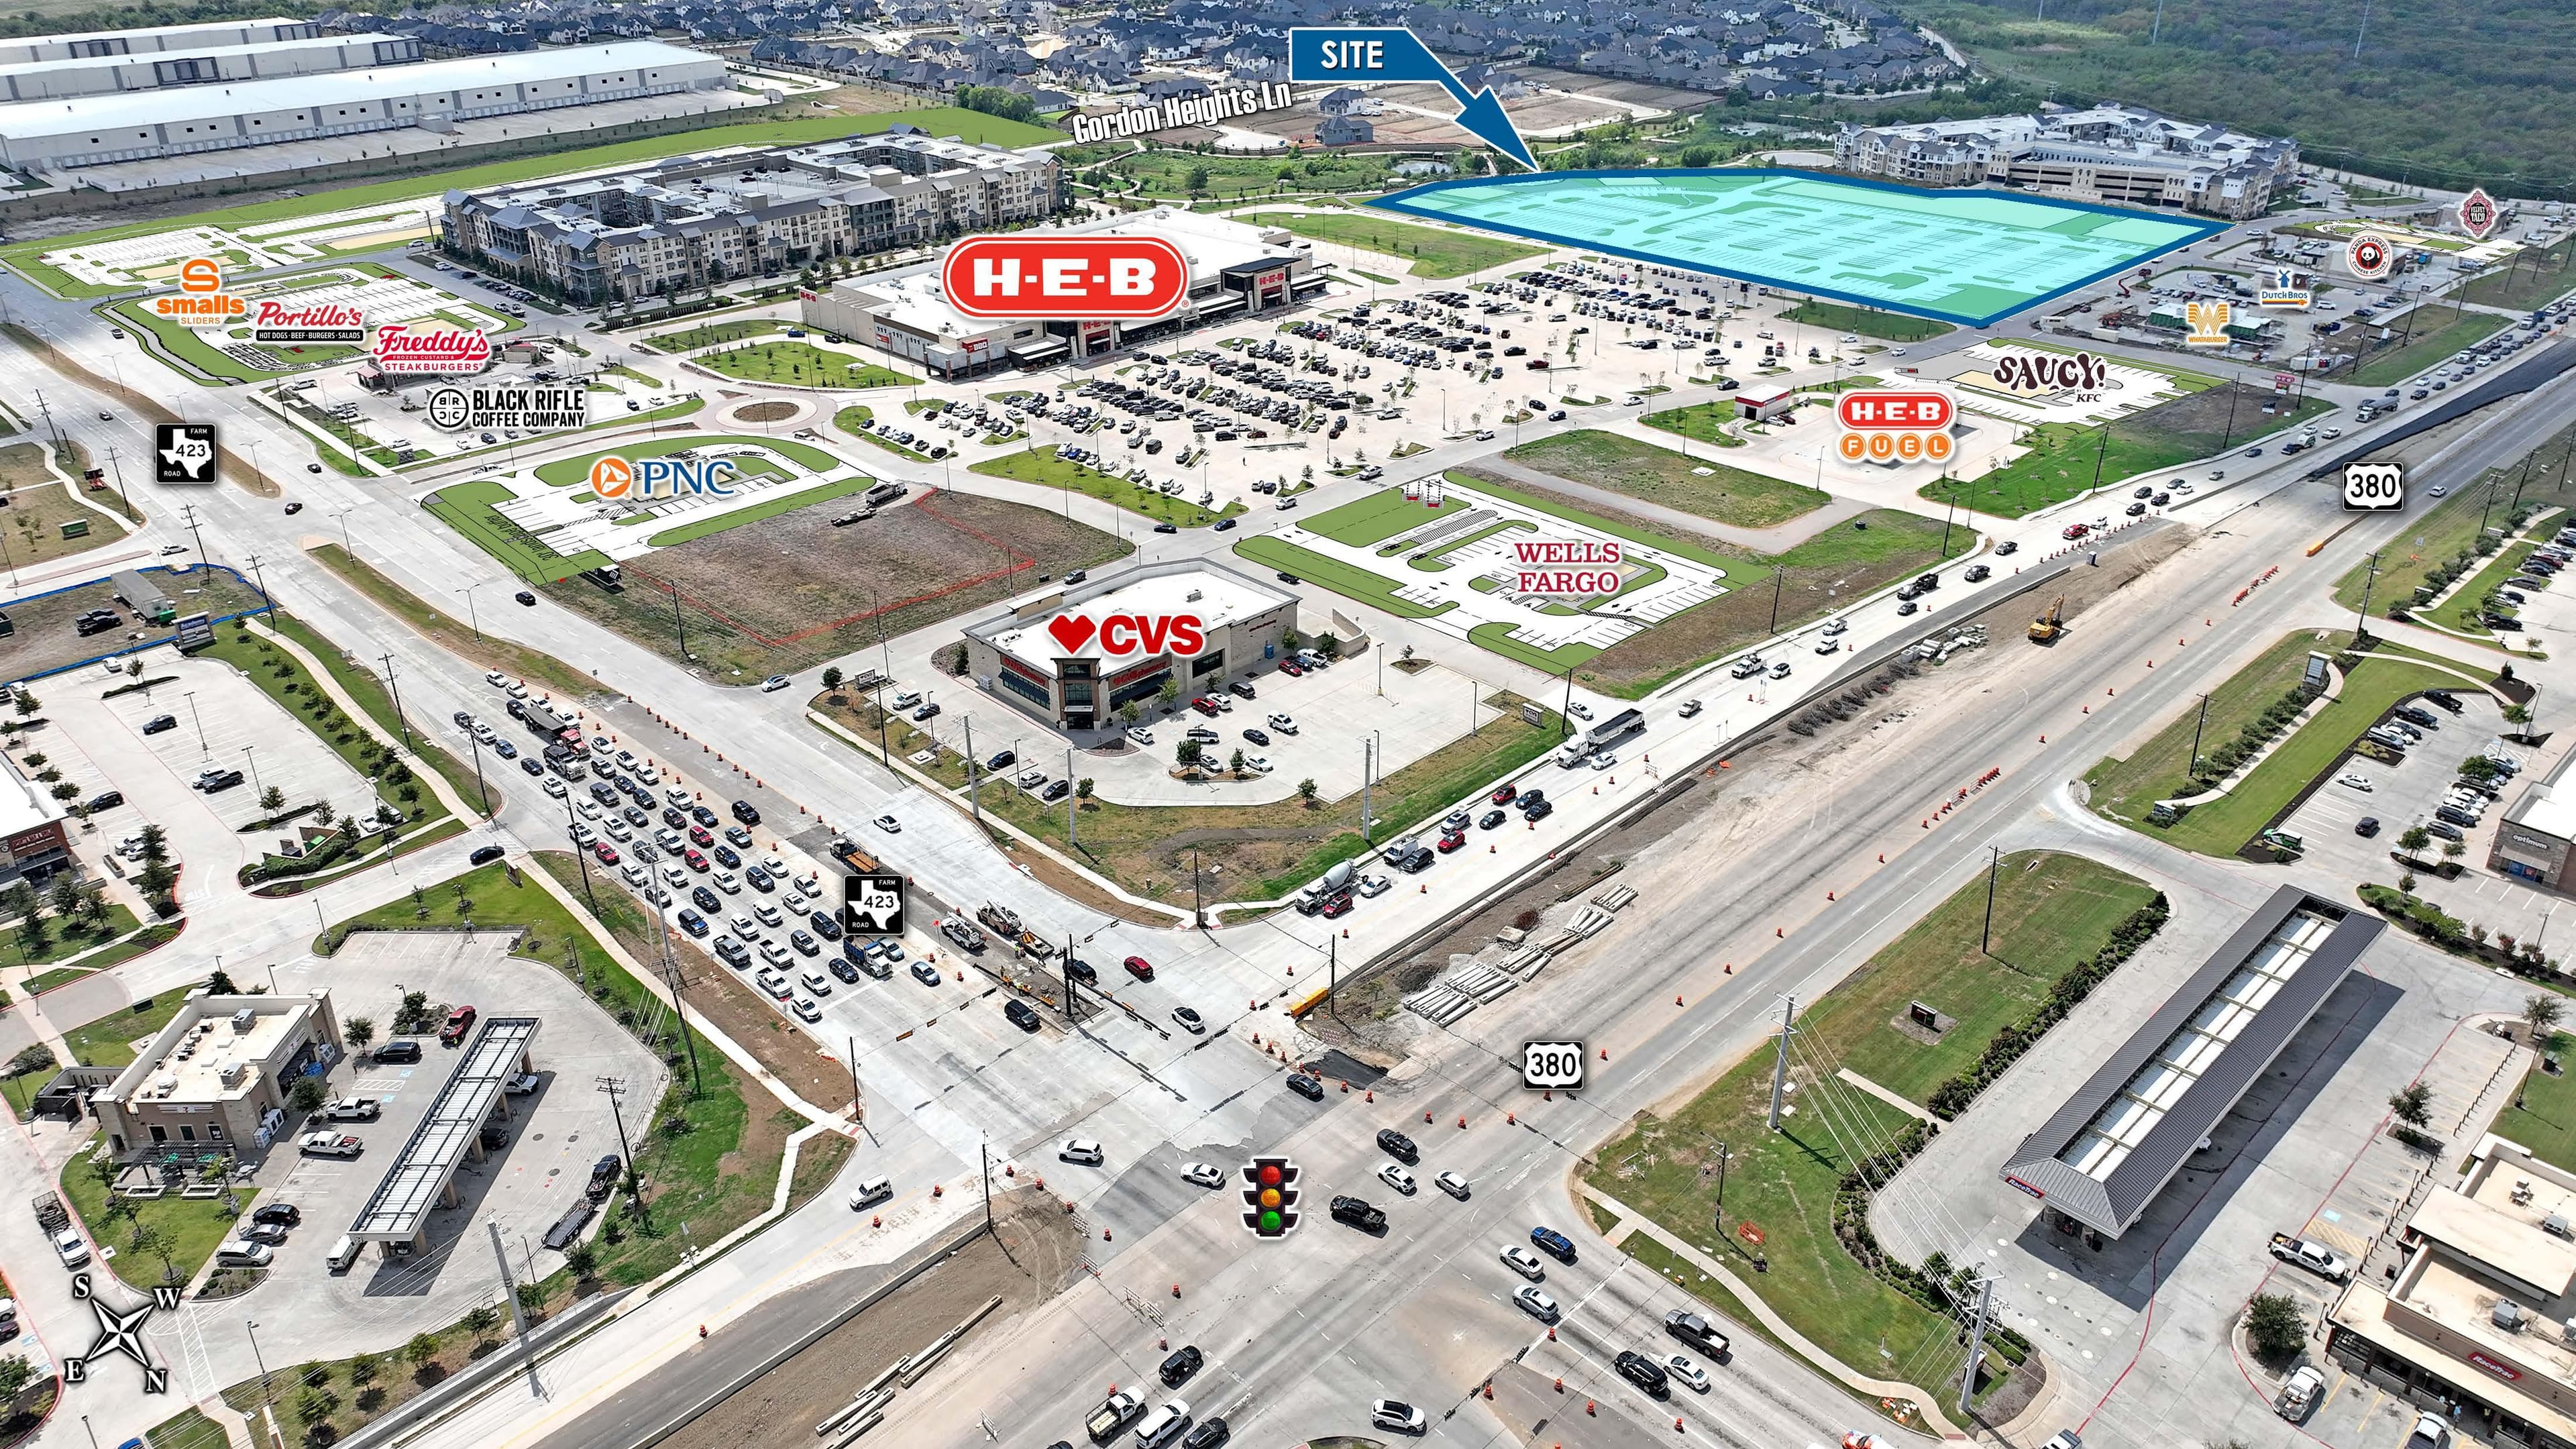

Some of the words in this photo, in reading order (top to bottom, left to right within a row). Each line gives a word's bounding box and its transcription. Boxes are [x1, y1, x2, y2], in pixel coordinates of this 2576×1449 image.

[2513, 835, 2548, 849] optimum
[2008, 1179, 2039, 1197] RaceTrac
[2472, 1355, 2515, 1379] RaceTrac
